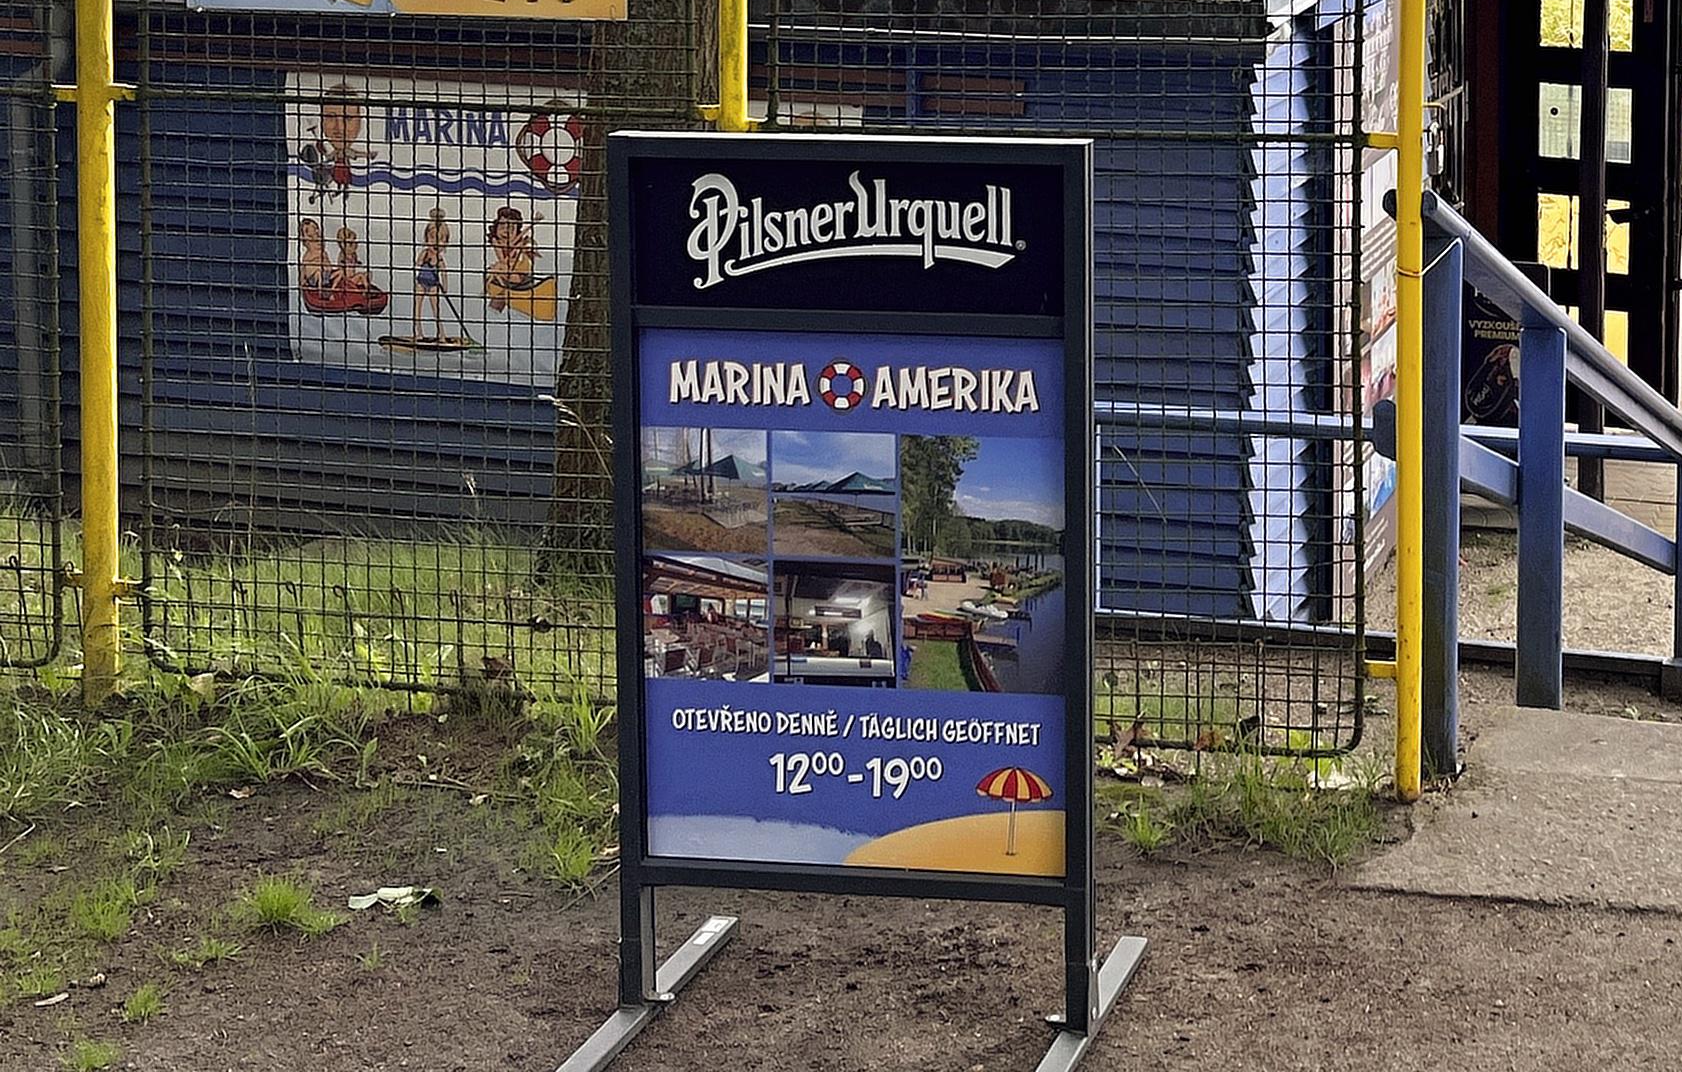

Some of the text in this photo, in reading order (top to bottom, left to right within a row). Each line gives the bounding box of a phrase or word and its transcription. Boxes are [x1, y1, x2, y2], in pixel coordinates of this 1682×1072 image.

[385, 106, 509, 149] MARINA
[686, 170, 1013, 290] Pilsner Urquell
[1468, 319, 1520, 331] VYZKOUŠE
[669, 359, 1040, 415] MARINA AMERIKA
[672, 704, 772, 733] OTEVŘENO
[776, 709, 839, 737] DENNĚ
[859, 712, 938, 741] TÄGLICH
[943, 718, 1041, 746] GEÖFFNET
